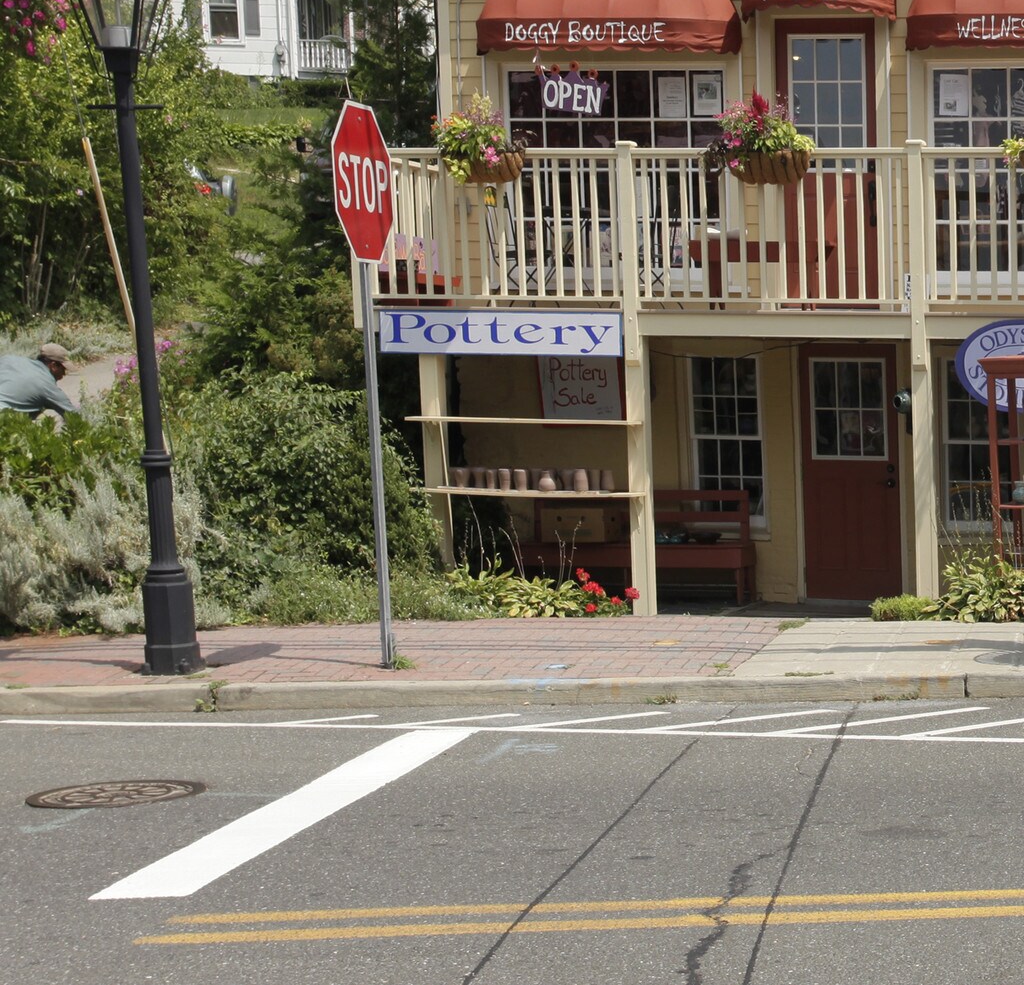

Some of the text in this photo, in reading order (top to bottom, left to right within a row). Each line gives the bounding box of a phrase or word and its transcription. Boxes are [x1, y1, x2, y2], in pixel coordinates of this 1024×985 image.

[505, 20, 666, 45] DOGGY BOUTIQUE
[543, 80, 601, 114] OPEN
[338, 152, 388, 214] STOP
[385, 313, 614, 354] Pottery
[549, 357, 607, 387] Pottery
[554, 387, 597, 407] Sale
